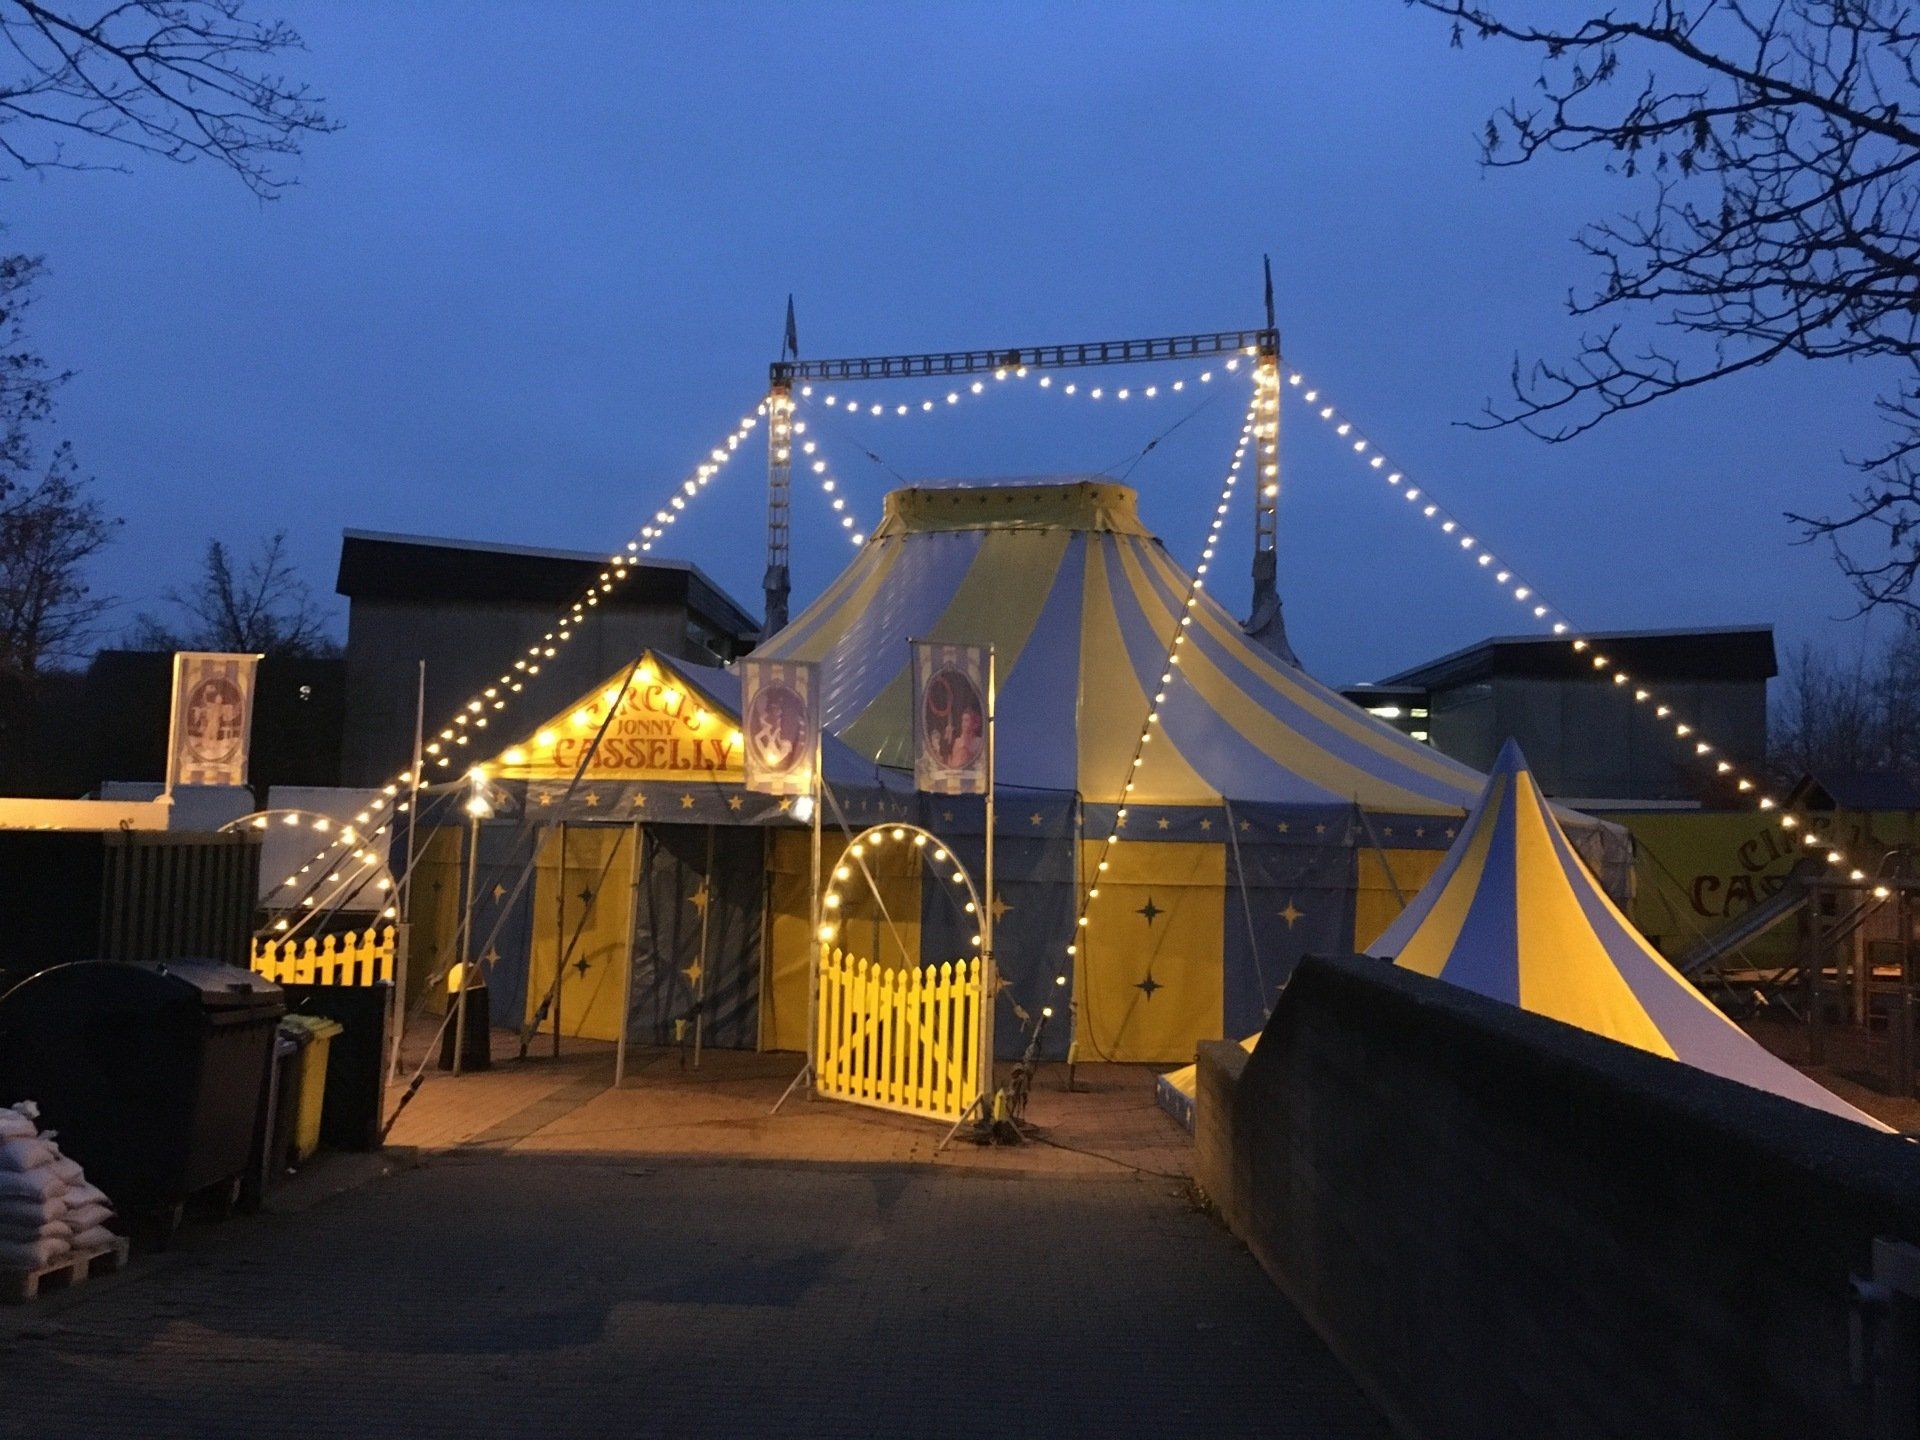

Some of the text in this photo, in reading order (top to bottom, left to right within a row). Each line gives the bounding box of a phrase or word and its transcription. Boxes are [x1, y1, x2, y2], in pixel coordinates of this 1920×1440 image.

[583, 685, 706, 732] CRCUS
[616, 719, 677, 736] JONNY
[551, 738, 734, 772] CASSELLY
